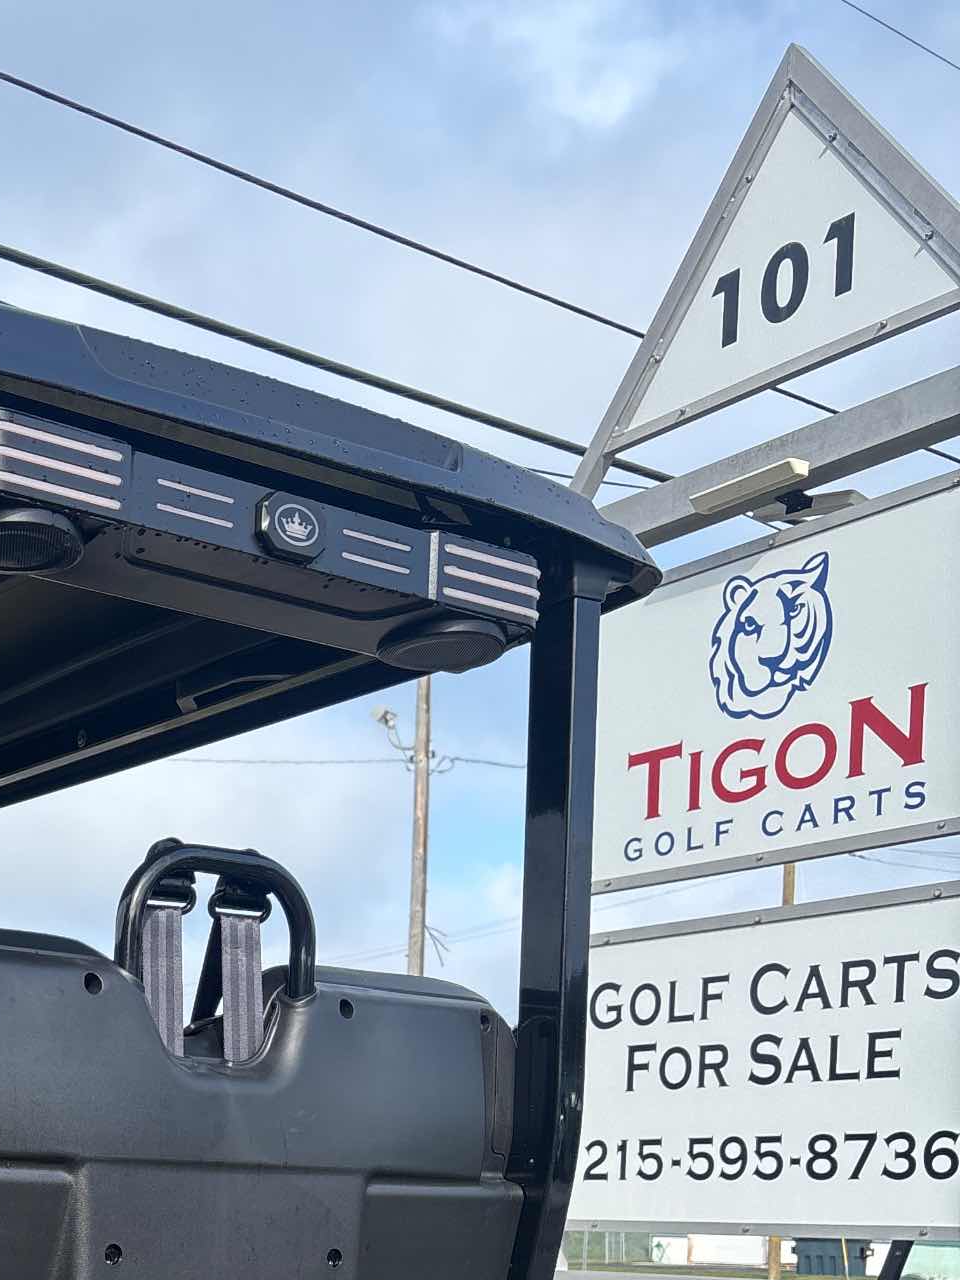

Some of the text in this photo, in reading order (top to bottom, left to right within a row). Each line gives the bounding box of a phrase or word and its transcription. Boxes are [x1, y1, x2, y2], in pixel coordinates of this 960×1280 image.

[711, 211, 856, 349] 101
[627, 682, 929, 821] TIGON
[623, 780, 927, 862] GOLF CARTS
[589, 948, 960, 1030] GOLF CARTS
[624, 1028, 903, 1092] FOR SALE
[582, 1130, 960, 1181] 215-595-8736
